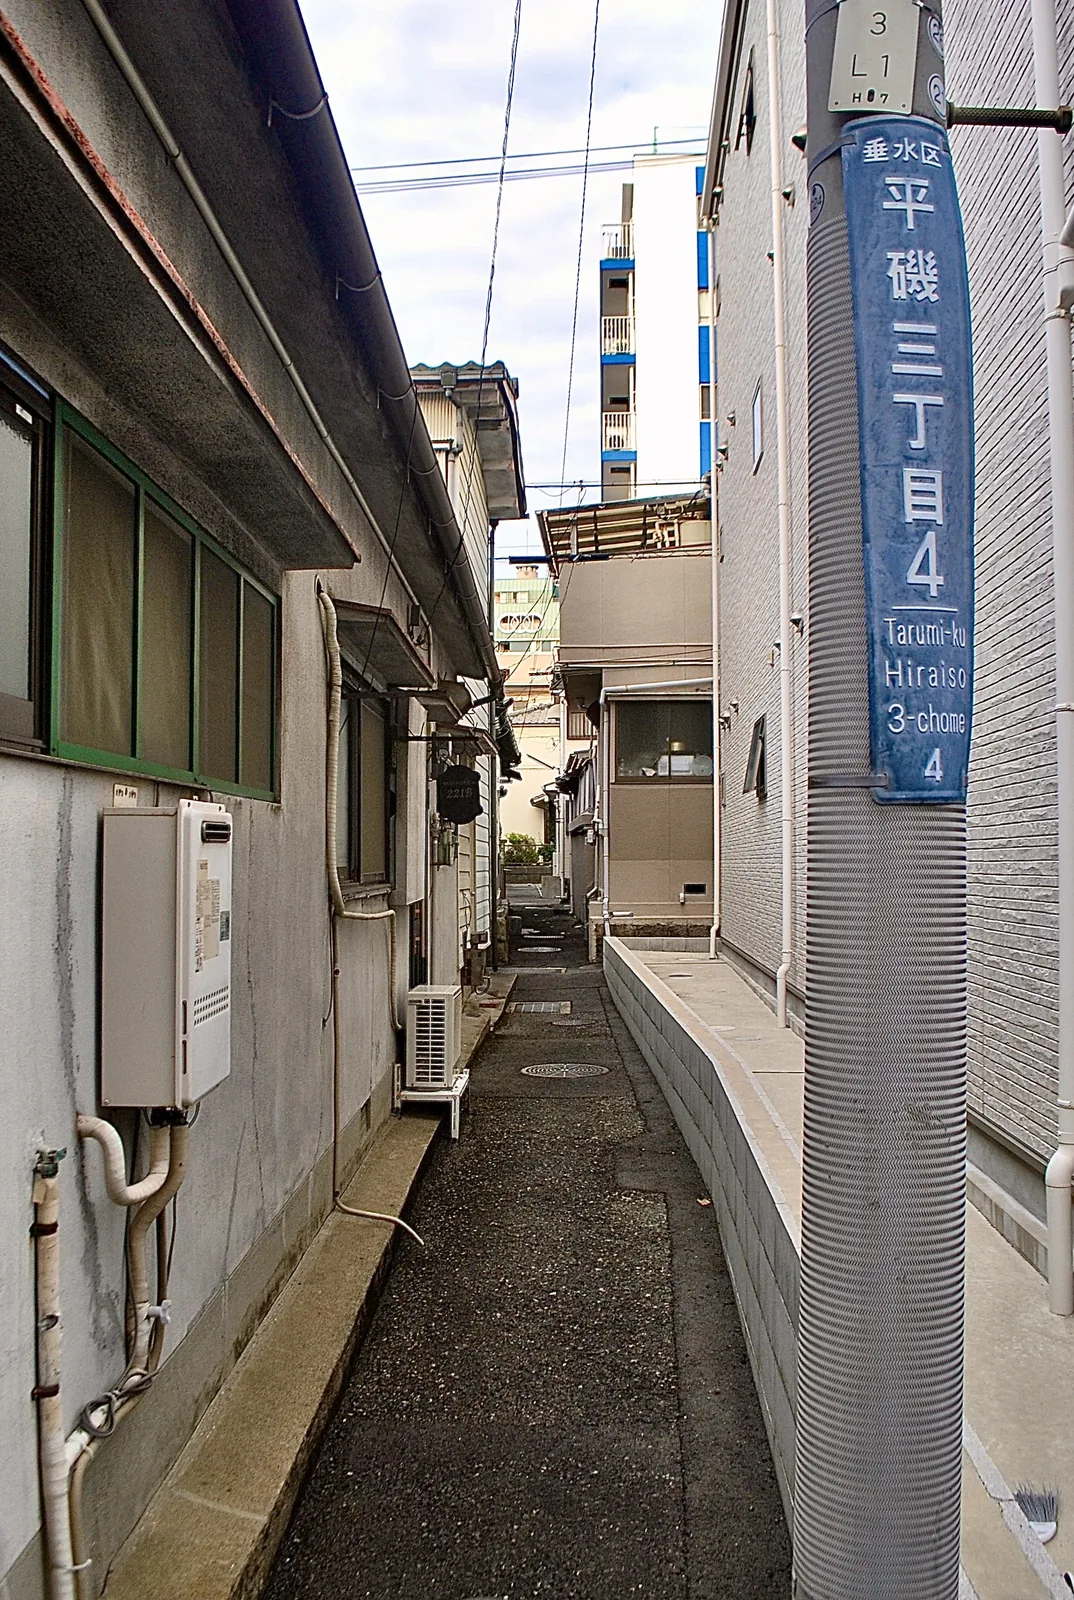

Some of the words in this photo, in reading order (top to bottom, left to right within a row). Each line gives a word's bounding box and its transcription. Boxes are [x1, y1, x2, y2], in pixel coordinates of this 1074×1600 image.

[870, 12, 887, 36] 3
[862, 137, 943, 168] 垂水区
[884, 617, 966, 649] Tarumi-ku
[884, 659, 966, 689] Hiraiso
[887, 703, 966, 735] 3-chome
[924, 748, 943, 783] 4
